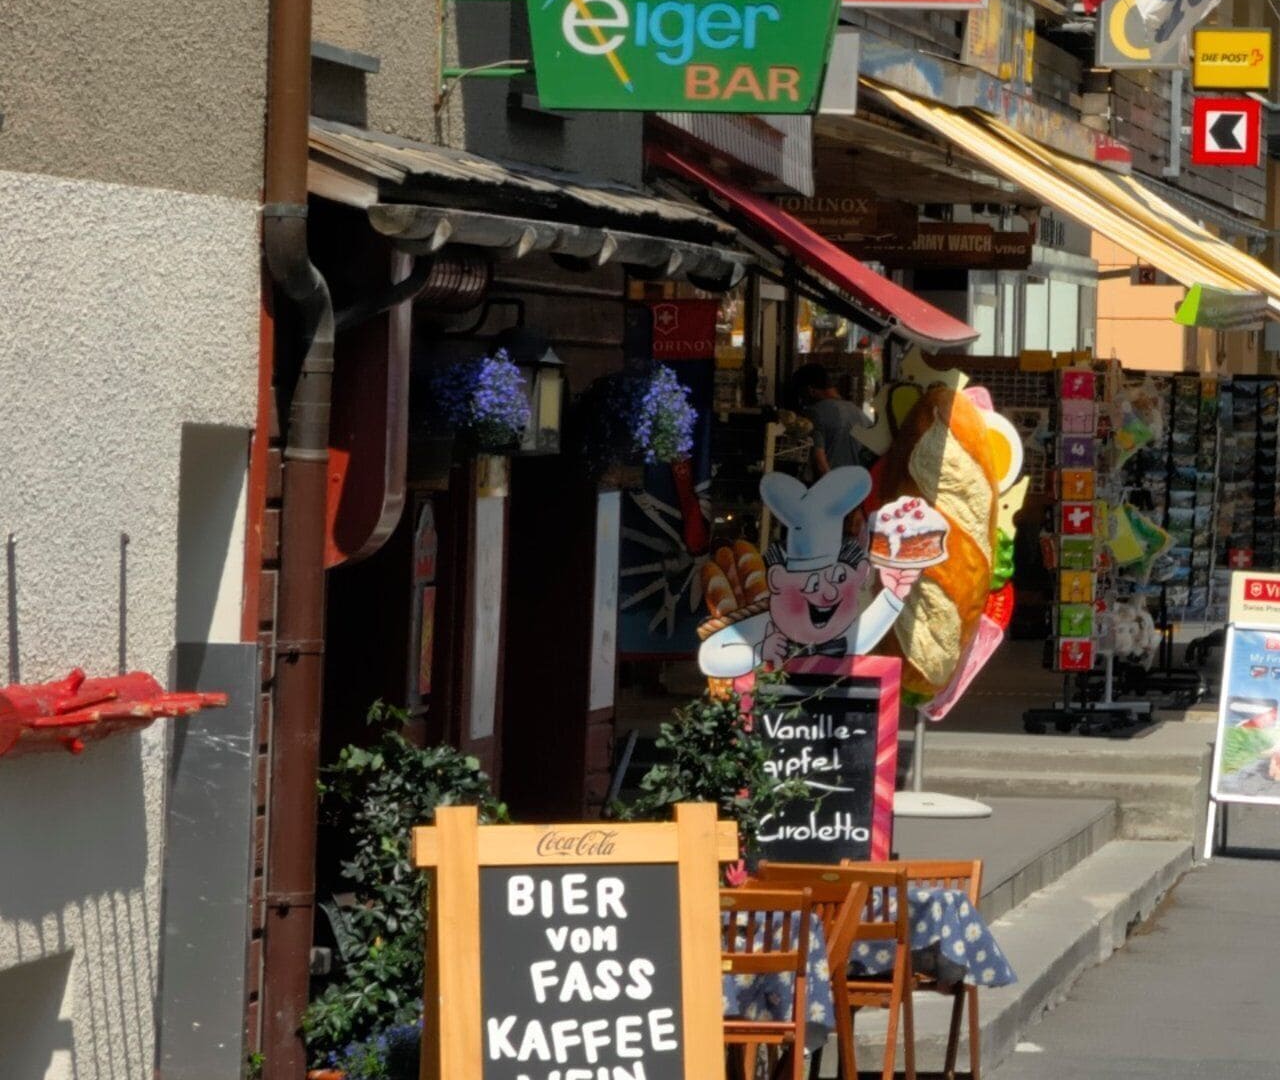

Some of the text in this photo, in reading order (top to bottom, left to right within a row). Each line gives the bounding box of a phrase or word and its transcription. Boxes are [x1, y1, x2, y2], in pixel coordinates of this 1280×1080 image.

[1201, 53, 1248, 63] DIE POST
[684, 64, 800, 101] BAR
[949, 234, 992, 253] WATCH
[536, 830, 618, 857] Coca-Cola
[507, 873, 628, 919] BIER
[529, 957, 656, 1004] FASS
[487, 1007, 678, 1064] KAFFEE
